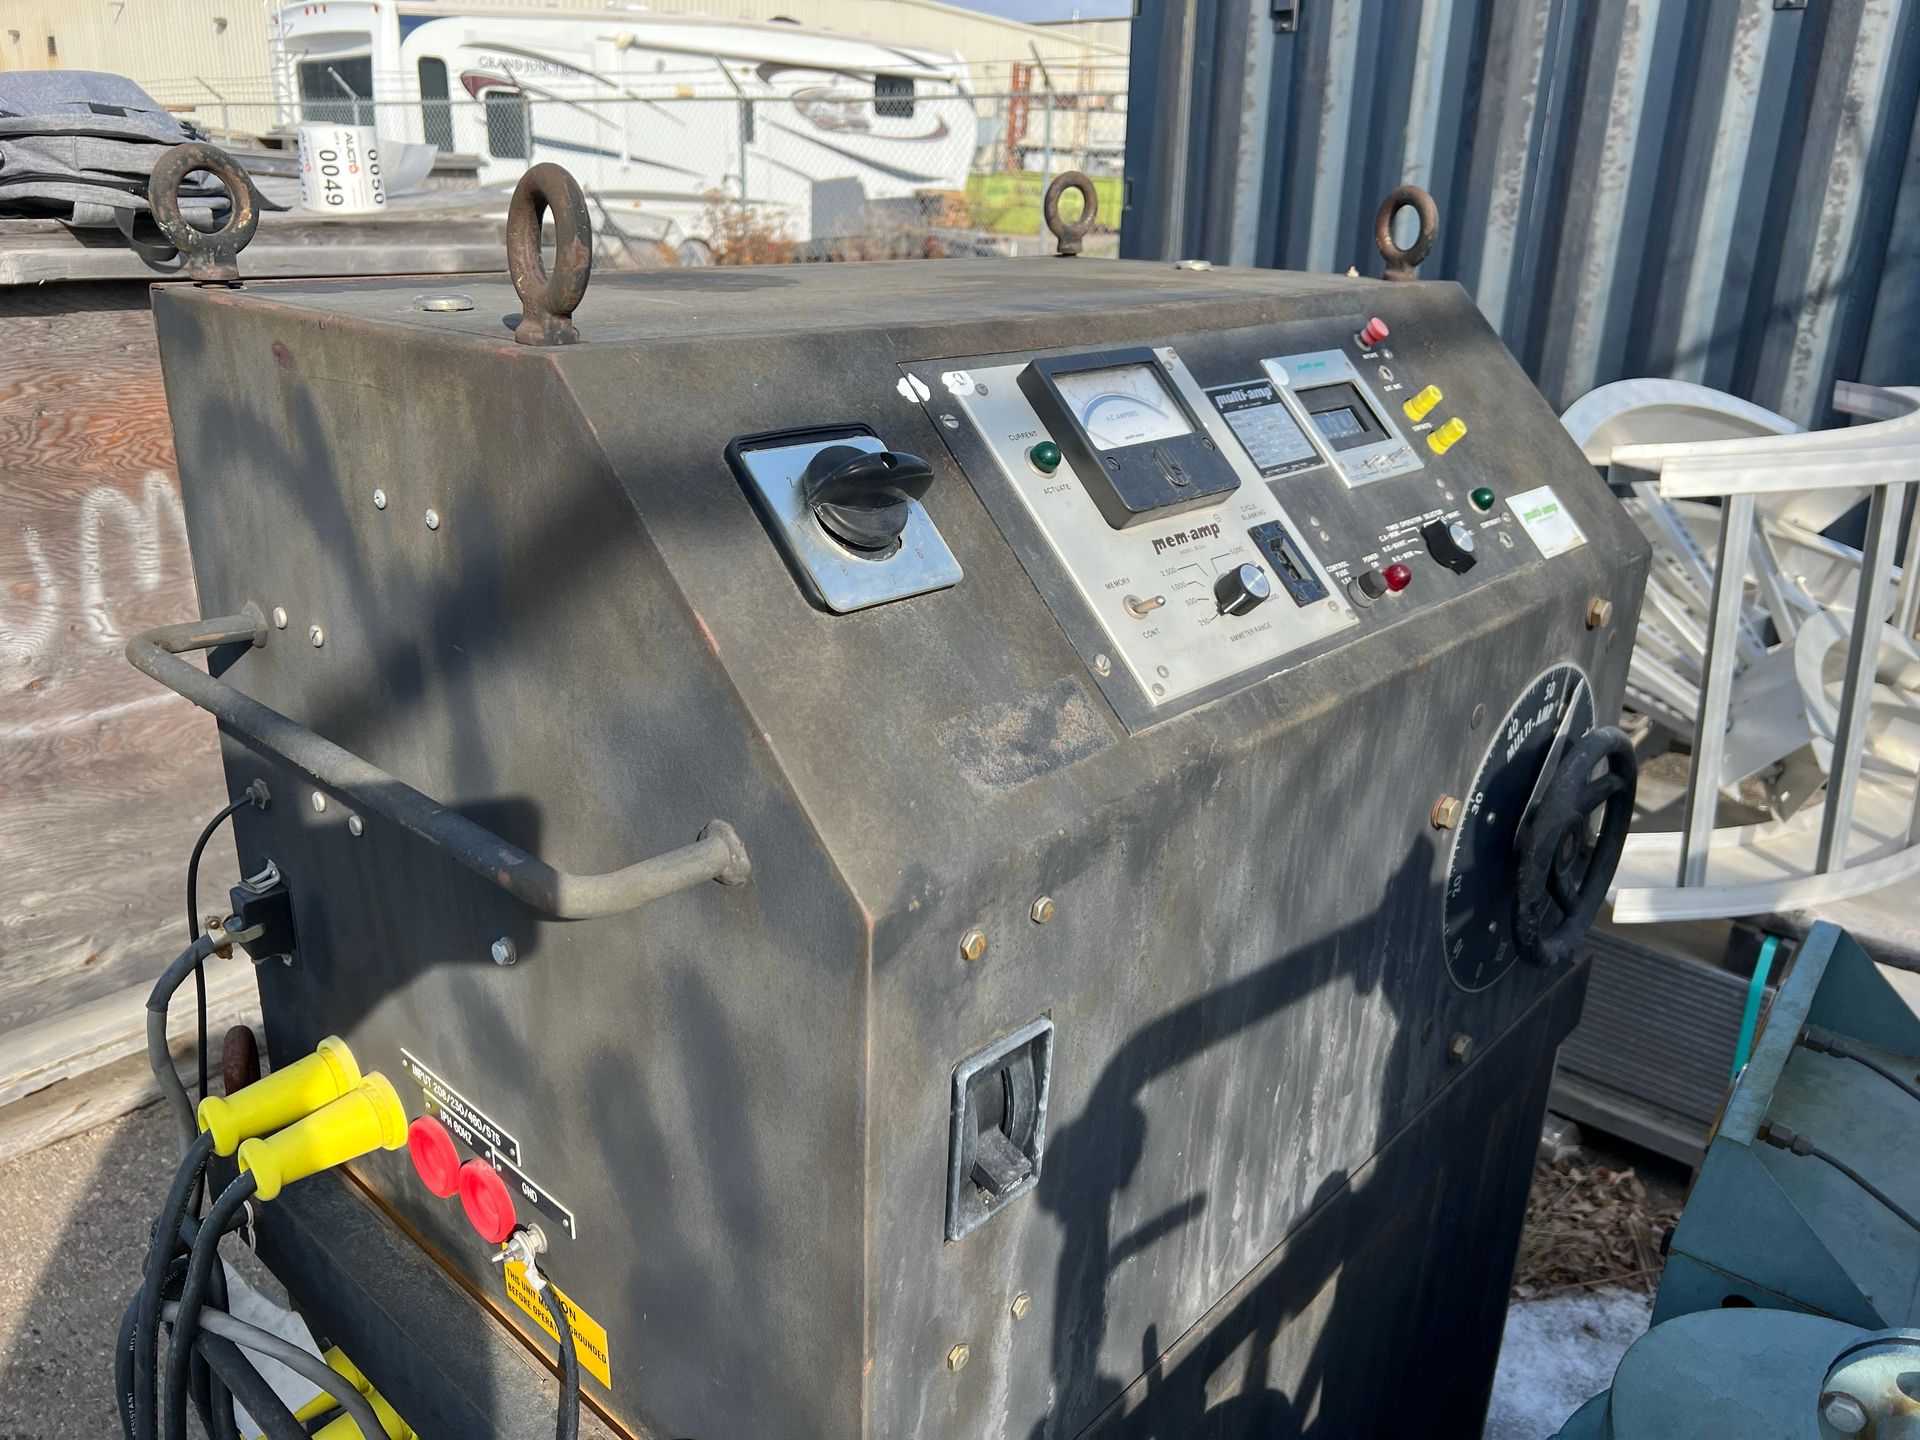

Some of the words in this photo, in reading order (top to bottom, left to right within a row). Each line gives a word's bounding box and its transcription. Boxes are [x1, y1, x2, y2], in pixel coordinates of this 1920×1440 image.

[319, 149, 345, 206] 0049
[1506, 702, 1554, 764] MULTI-AMP
[1507, 717, 1519, 741] 40
[1471, 791, 1483, 816] 30
[412, 1063, 432, 1088] INPUT
[521, 1181, 538, 1203] GND
[507, 1267, 521, 1288] THIS
[521, 1281, 536, 1300] UNIT
[508, 1282, 532, 1311] BEFORE
